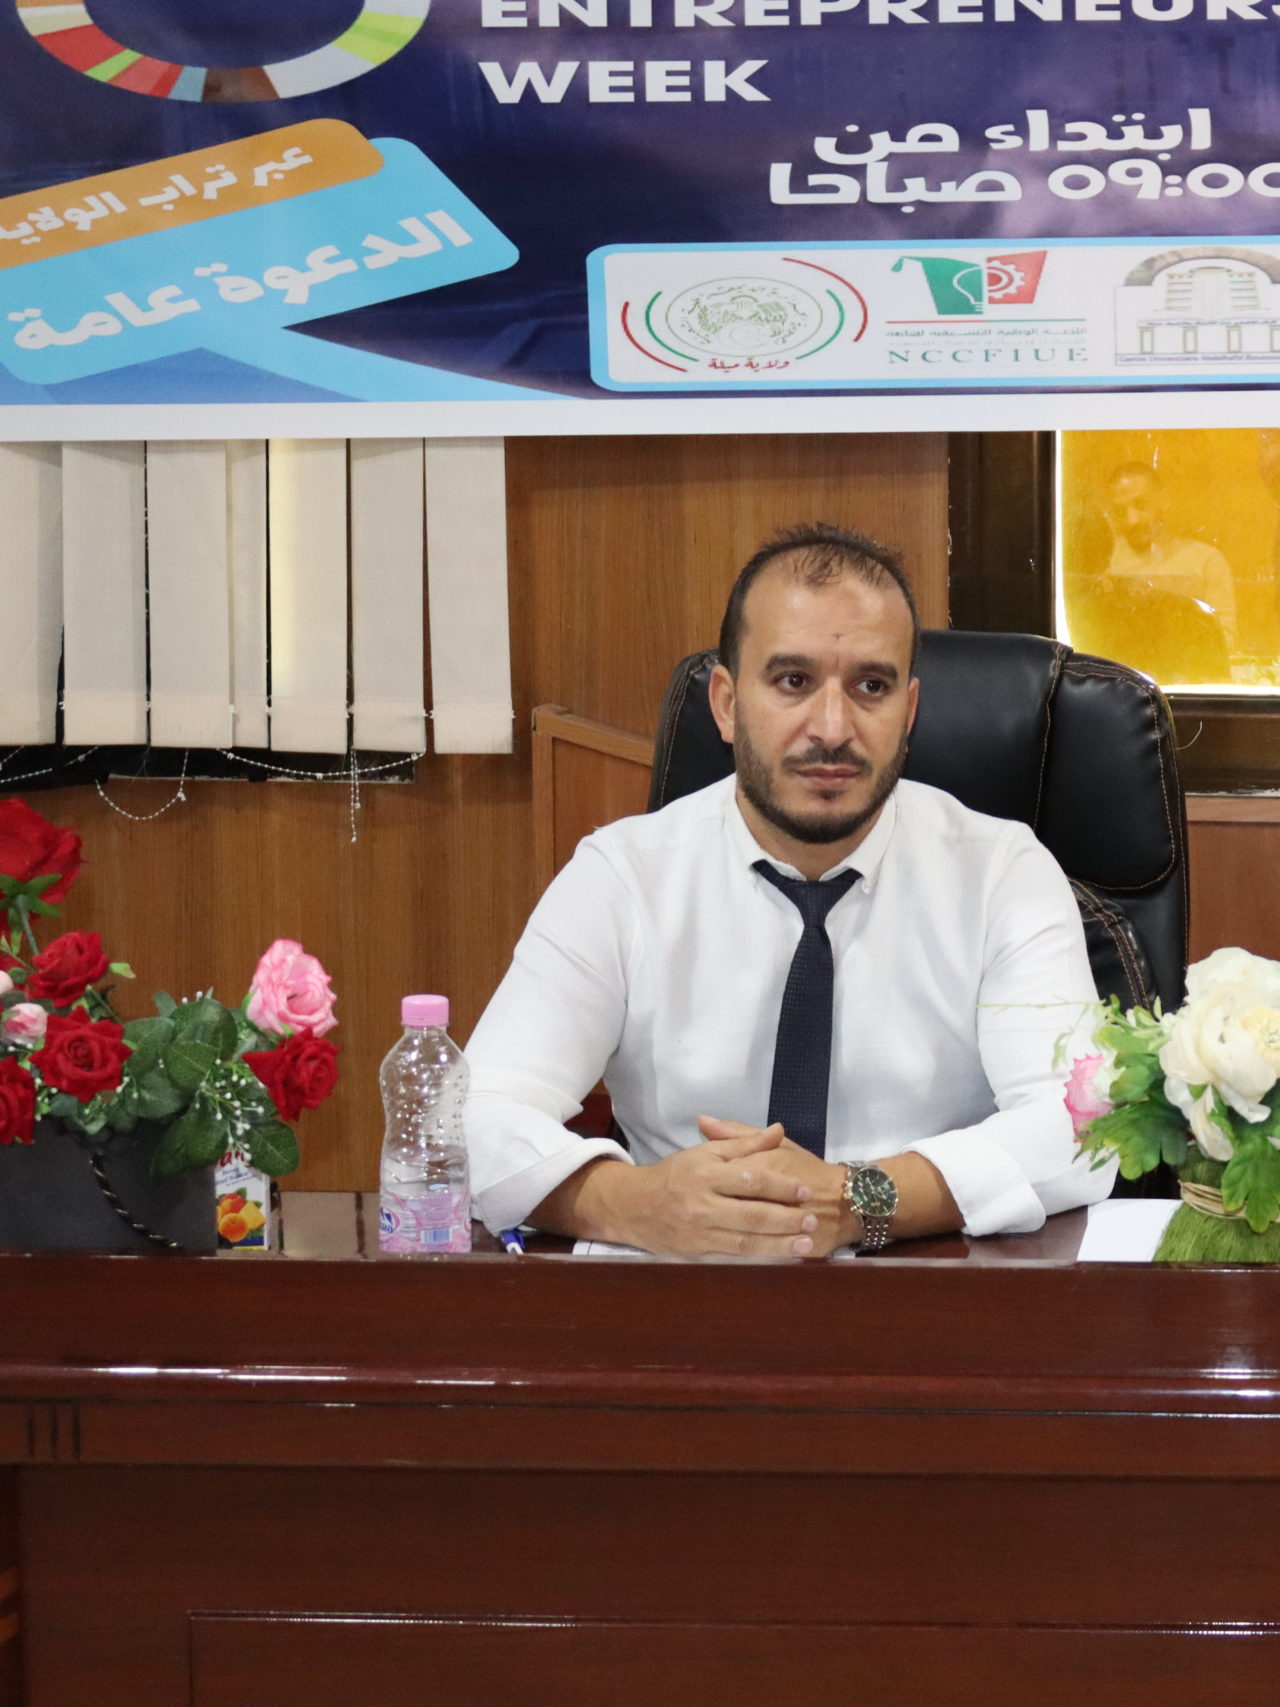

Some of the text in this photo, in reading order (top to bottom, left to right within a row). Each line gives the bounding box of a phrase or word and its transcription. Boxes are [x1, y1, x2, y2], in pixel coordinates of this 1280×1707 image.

[478, 60, 772, 104] WEEK
[814, 107, 1212, 165] ابتداء من
[0, 146, 314, 245] عبر تراب الولاي
[769, 161, 1023, 214] صباحا
[7, 209, 474, 350] الدعوة عامة
[707, 356, 790, 373] ولاية ميلة
[887, 348, 1088, 364] NCCFIUE
